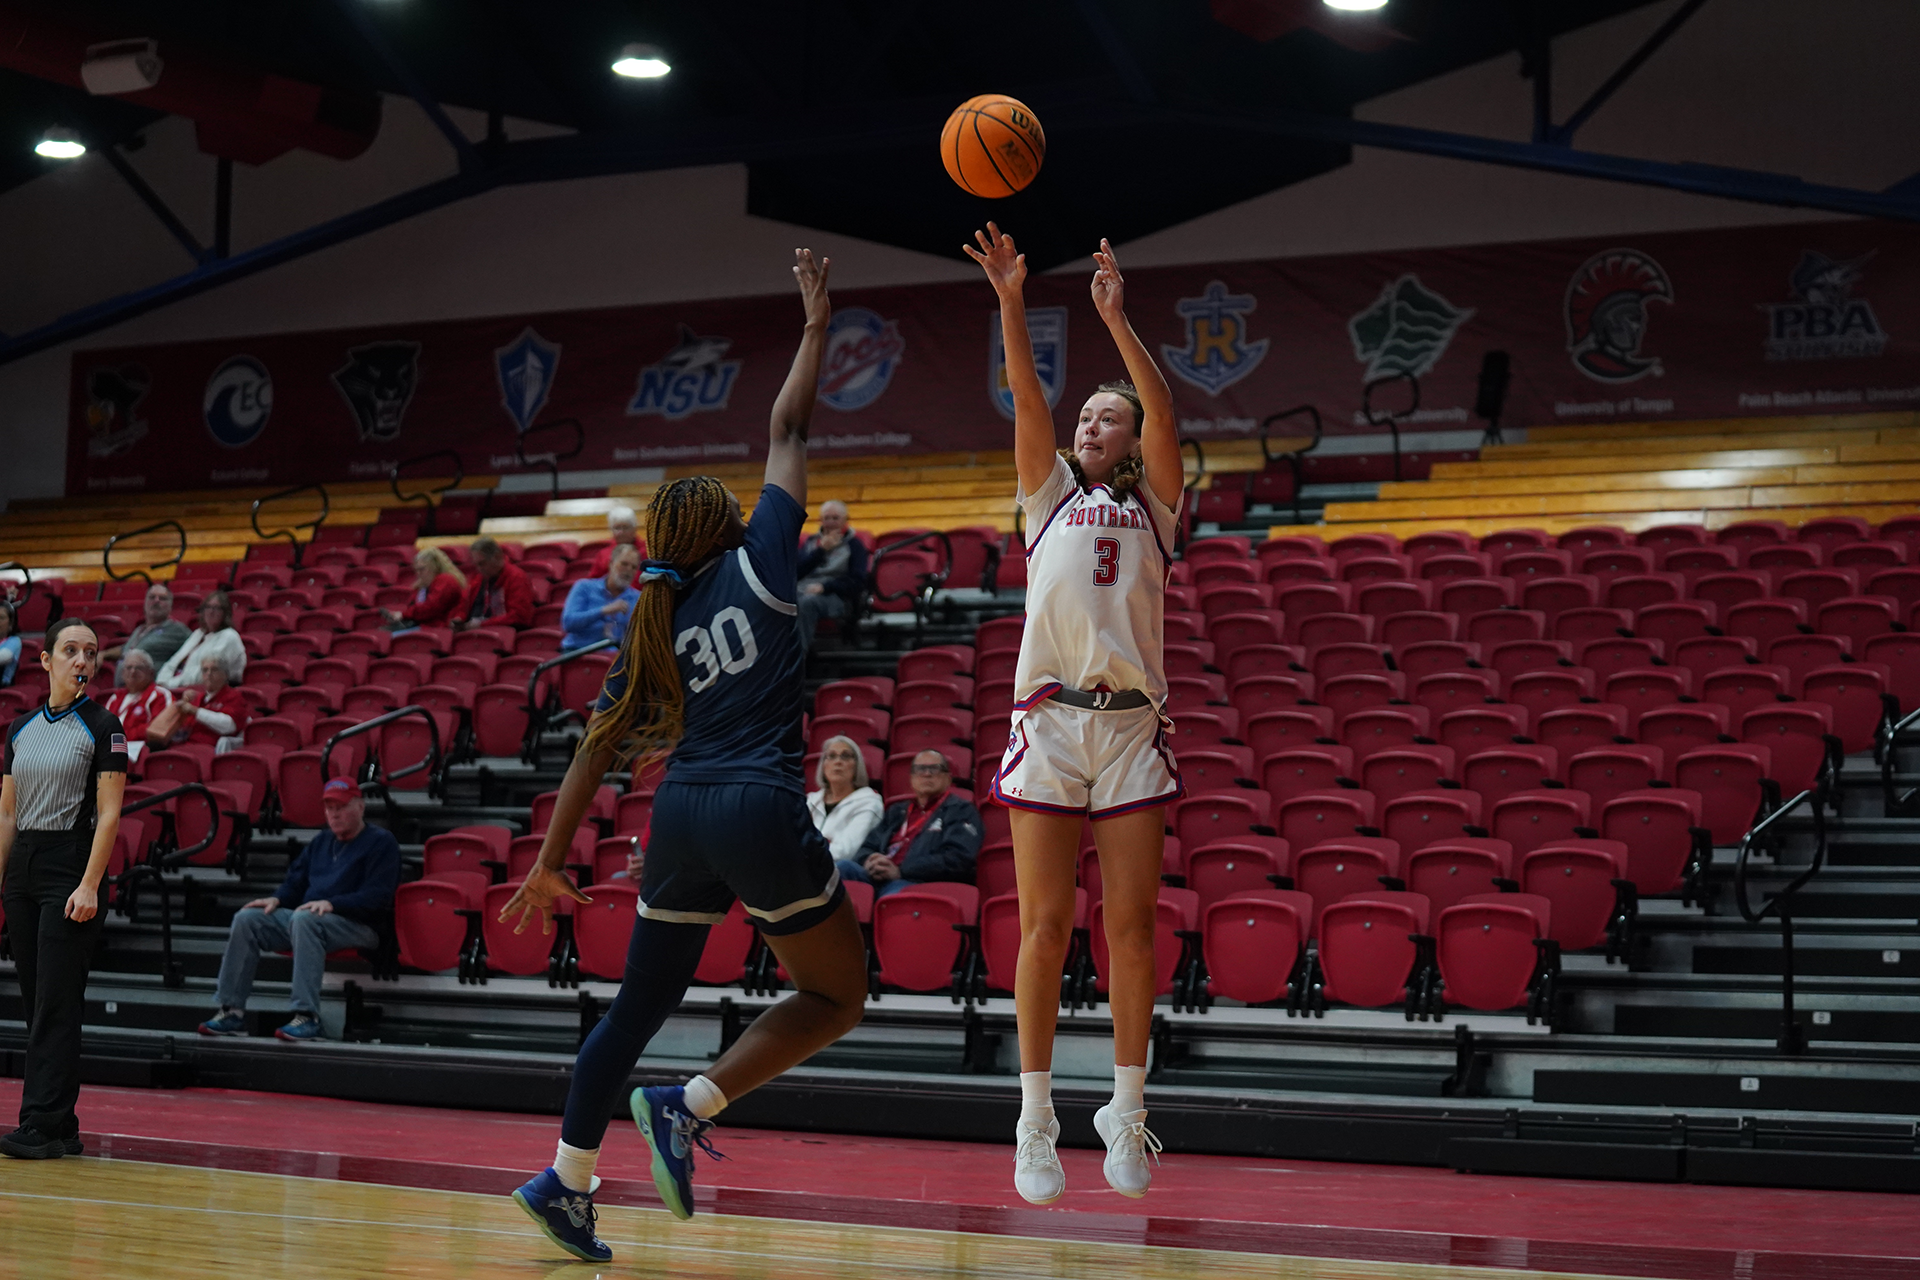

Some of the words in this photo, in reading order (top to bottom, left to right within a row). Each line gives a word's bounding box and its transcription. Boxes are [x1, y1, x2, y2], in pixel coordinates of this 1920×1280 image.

[1192, 317, 1239, 367] R
[1774, 304, 1877, 340] PBA
[630, 362, 741, 417] NSU
[1093, 536, 1121, 587] 3
[674, 605, 759, 694] 30
